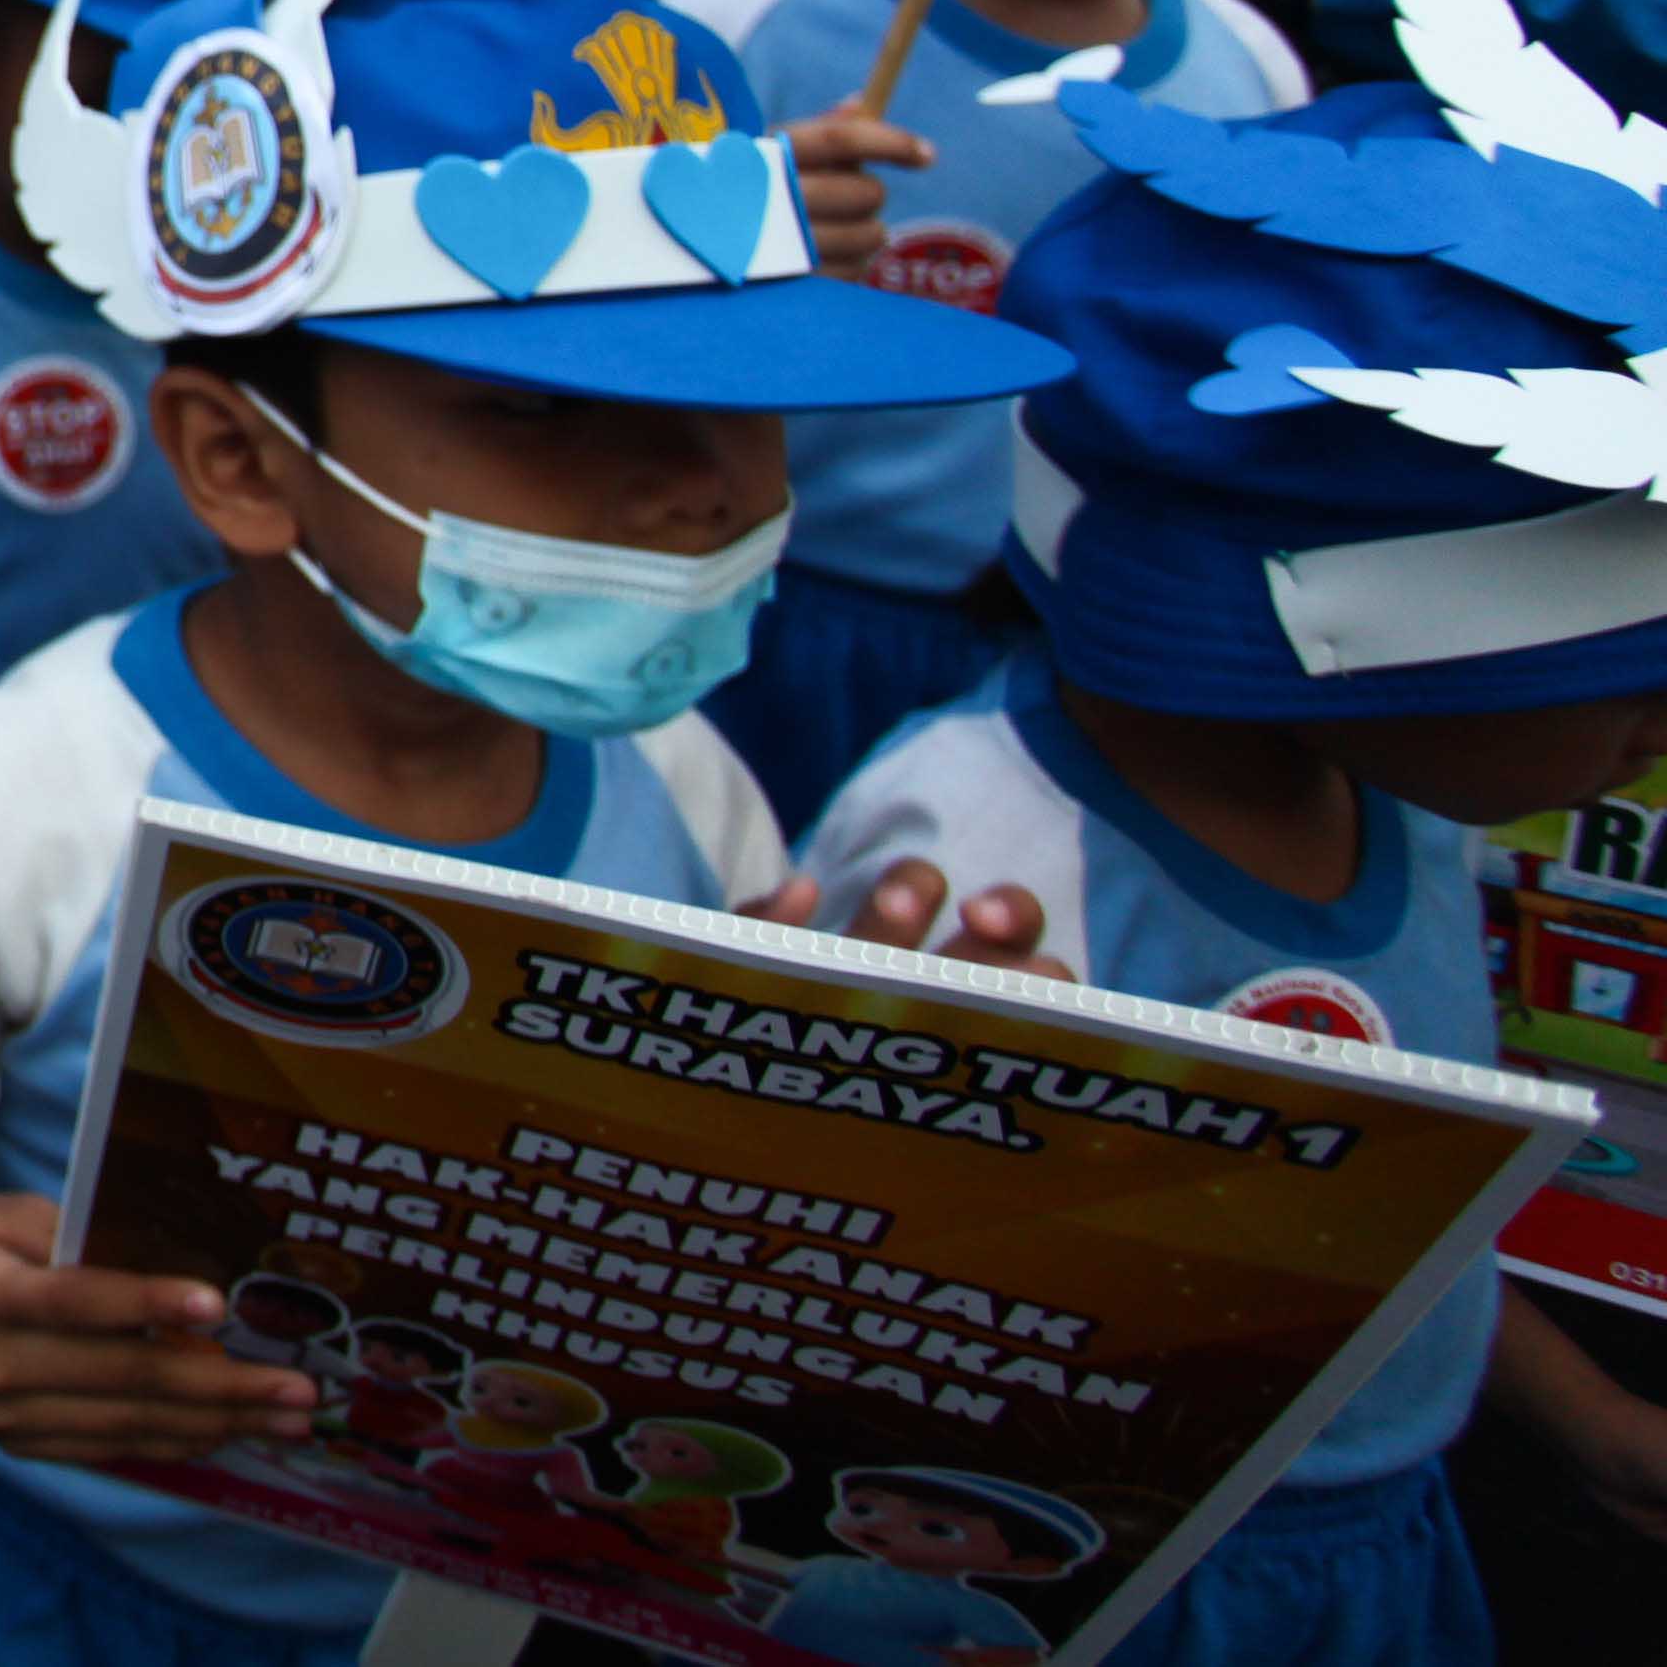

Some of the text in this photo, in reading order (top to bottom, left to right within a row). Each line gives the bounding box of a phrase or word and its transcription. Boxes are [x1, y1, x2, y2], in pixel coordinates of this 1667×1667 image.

[880, 258, 993, 295] STOP
[5, 397, 106, 434] STOP
[503, 999, 1033, 1150] SURABAYA.
[525, 952, 1348, 1165] TK HANG TUAH 1
[294, 1121, 1094, 1353] HAK-HAK ANAK
[508, 1126, 885, 1245] PENUHI
[206, 1143, 1155, 1415] YANG MEMERLUKAN
[283, 1208, 1008, 1425] PERLINDUNGAN
[429, 1289, 796, 1407] KHUSUS
